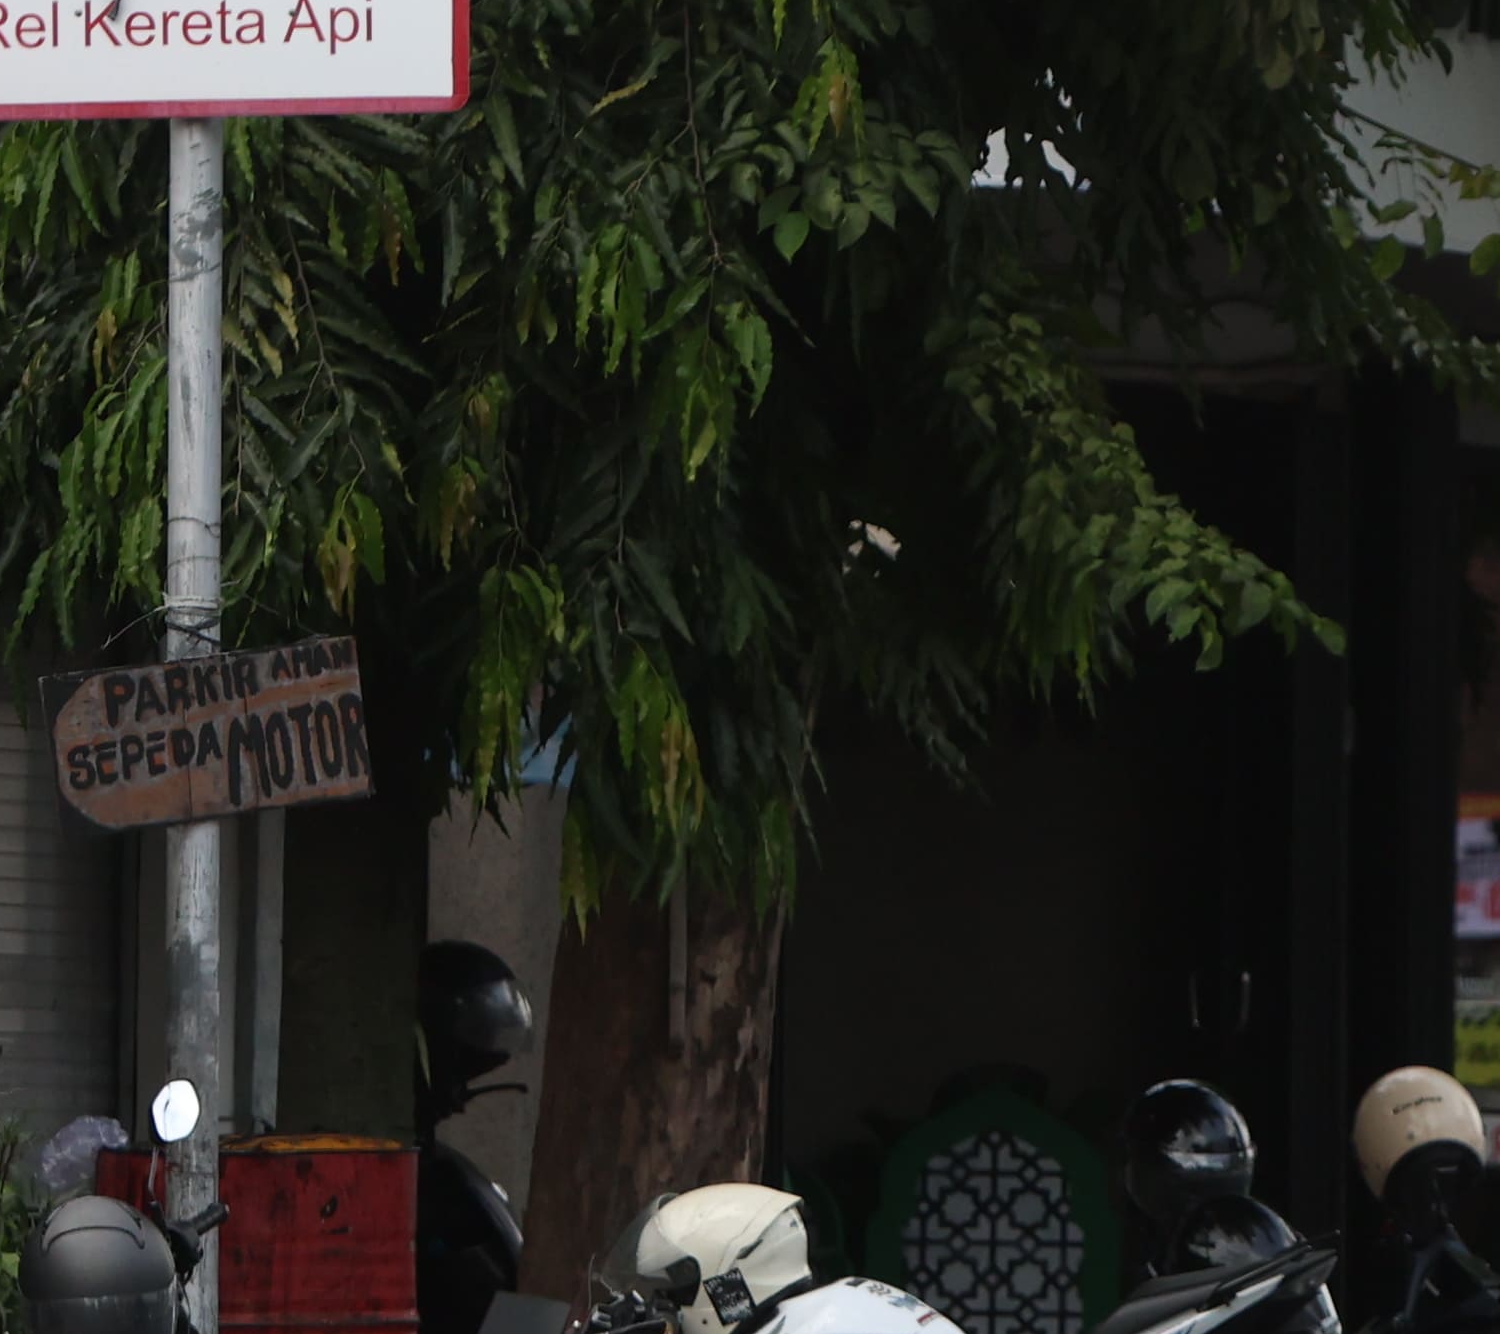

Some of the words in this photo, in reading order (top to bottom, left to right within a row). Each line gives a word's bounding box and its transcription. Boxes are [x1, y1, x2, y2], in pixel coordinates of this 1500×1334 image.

[103, 657, 259, 727] PARKIR
[68, 721, 223, 791] SEPEDA
[228, 693, 368, 807] MOTOR
